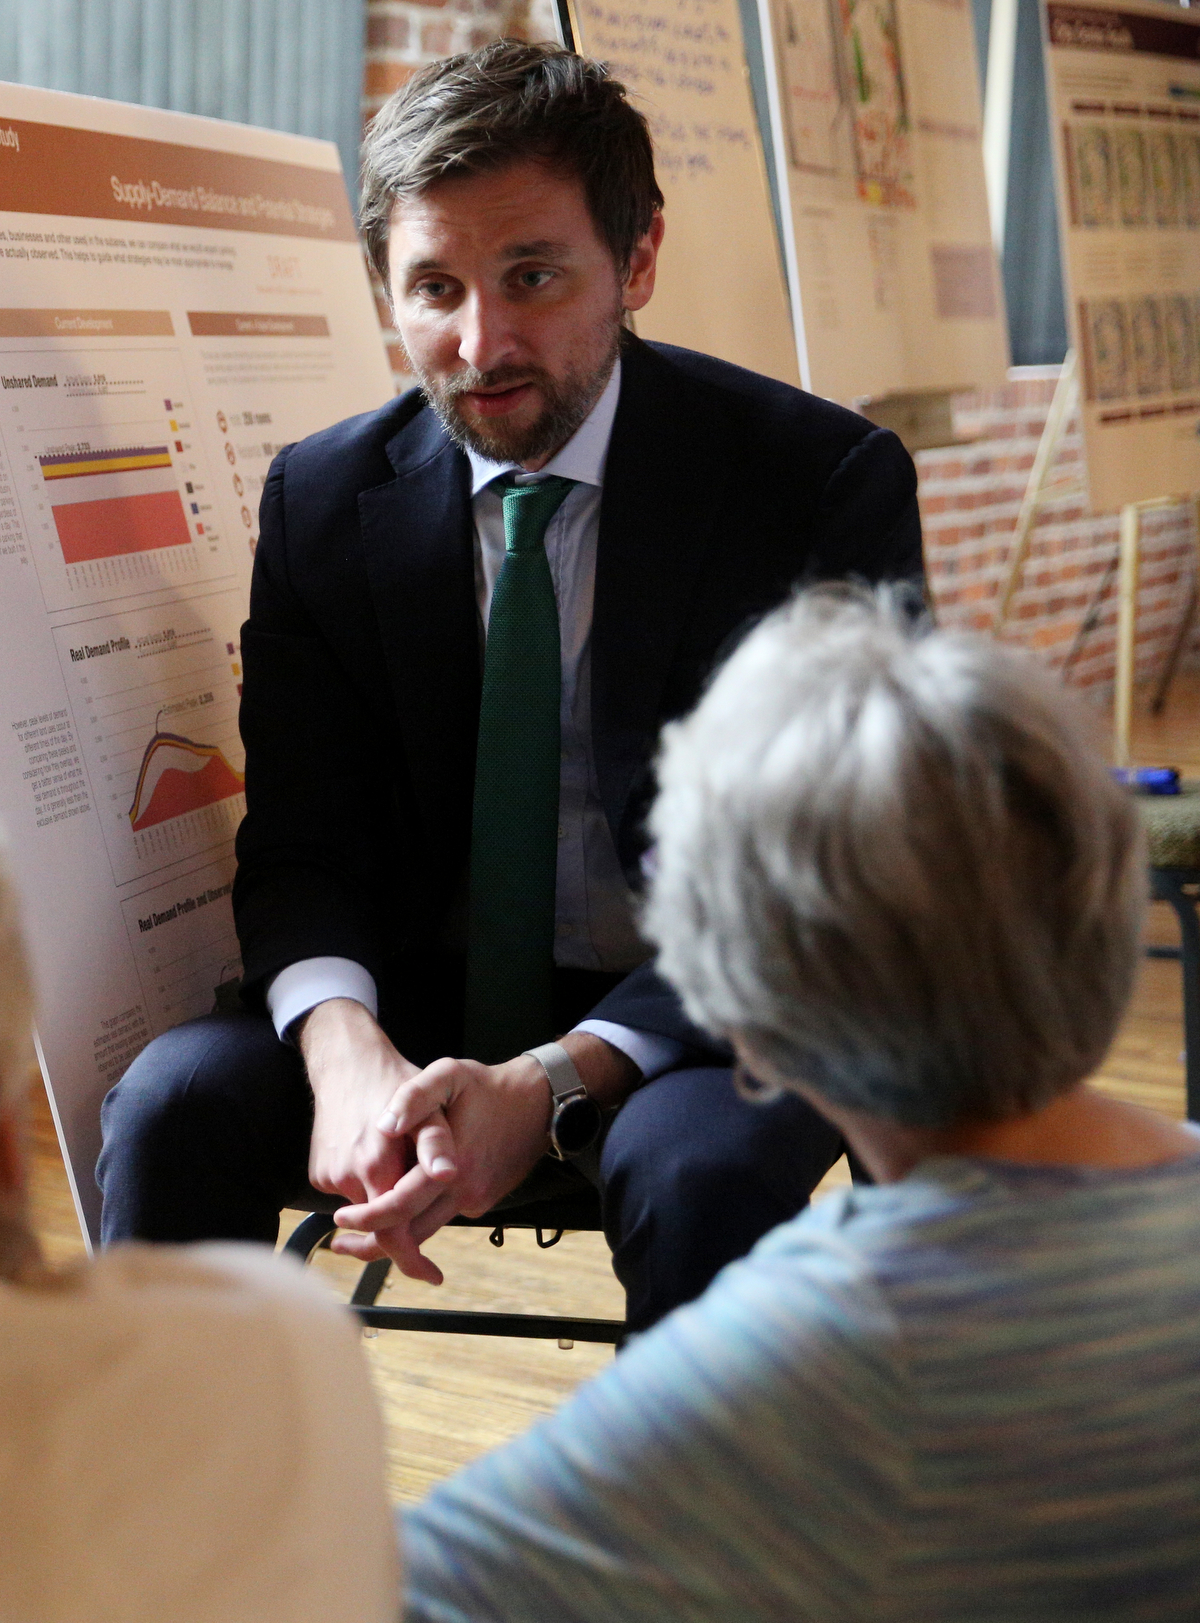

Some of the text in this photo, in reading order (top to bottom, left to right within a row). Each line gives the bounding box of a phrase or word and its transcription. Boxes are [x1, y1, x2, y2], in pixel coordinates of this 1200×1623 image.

[110, 175, 197, 211] Supply-Demand
[5, 247, 30, 261] actually
[1, 374, 33, 390] Unshared
[32, 373, 59, 388] Demand
[69, 646, 86, 663] Real
[85, 641, 111, 660] Demand
[110, 636, 131, 654] Profile
[137, 914, 154, 933] Real
[152, 904, 178, 928] Demand
[177, 897, 197, 917] Profile
[196, 891, 208, 909] and
